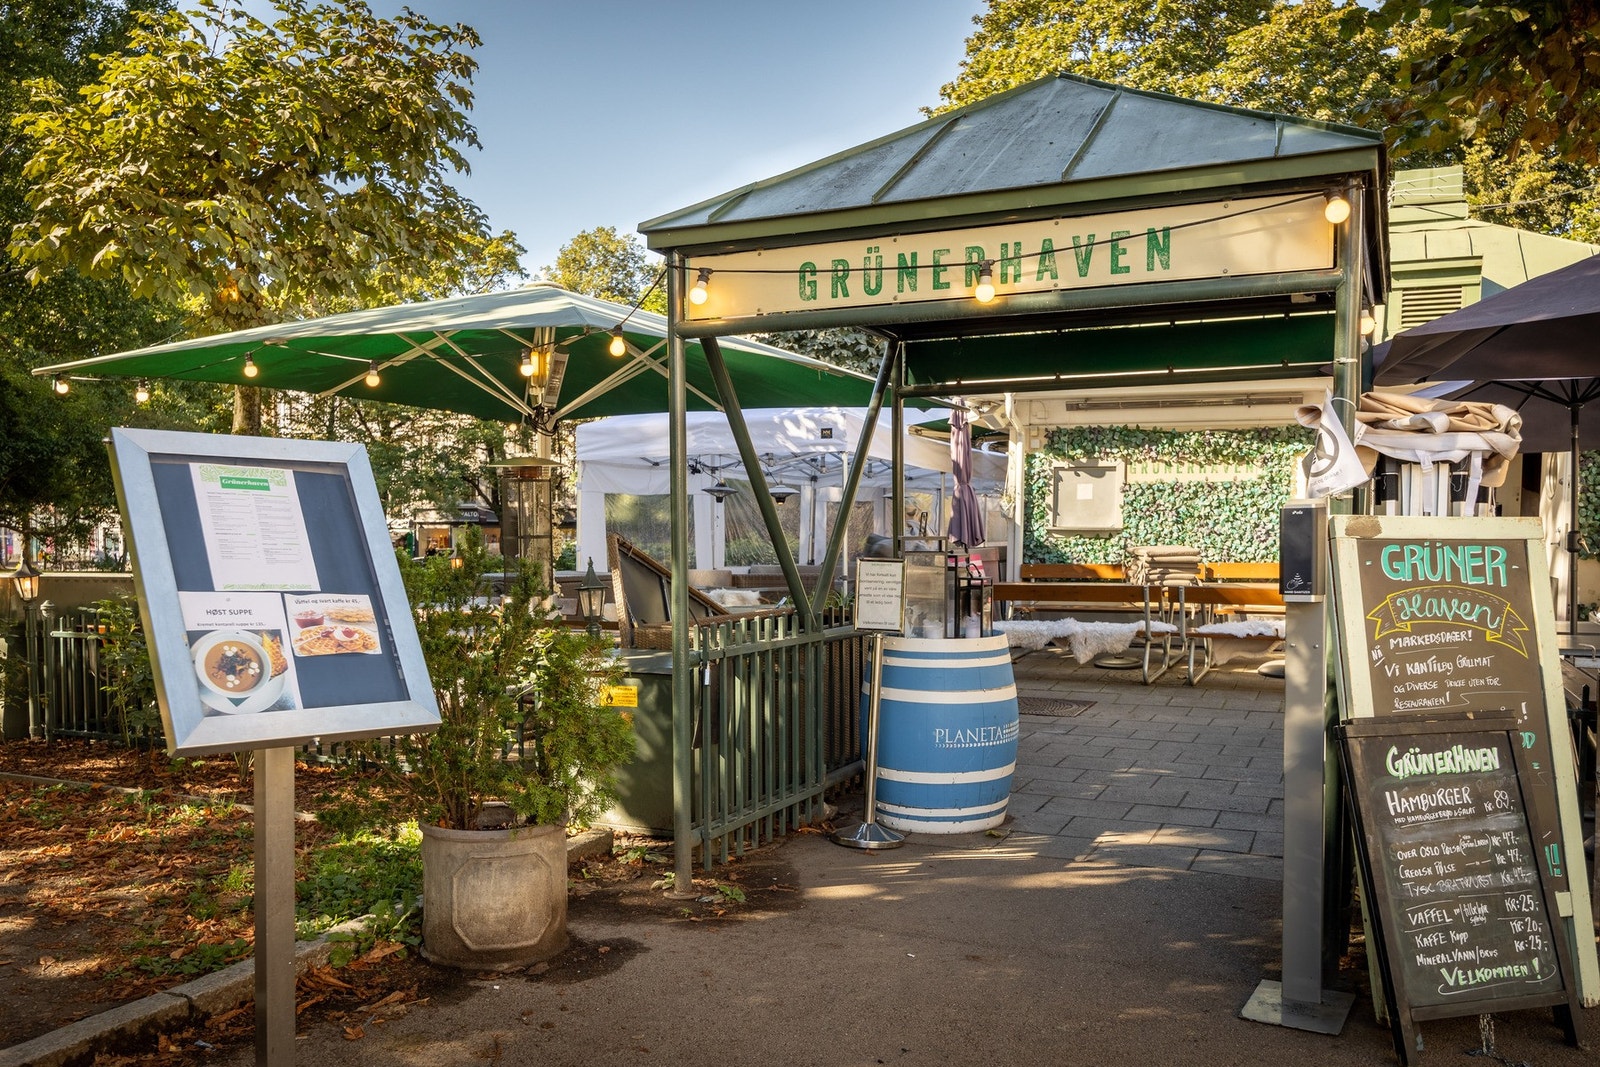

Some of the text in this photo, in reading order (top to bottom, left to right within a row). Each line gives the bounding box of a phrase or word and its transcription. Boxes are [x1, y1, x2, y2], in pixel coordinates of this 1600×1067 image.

[799, 226, 1171, 301] GRÜNERHAVEN
[1380, 541, 1508, 587] GRÜNER
[1396, 593, 1501, 629] Haven
[935, 726, 1004, 743] PLANETA
[1385, 744, 1501, 780] GRÜNERHAVEN
[1385, 786, 1472, 816] HAMBURGER
[1397, 848, 1418, 861] OVER
[1420, 845, 1440, 858] OSLO
[1433, 860, 1456, 877] PØLSE
[1436, 873, 1494, 893] BRATWURST
[1408, 907, 1453, 926] VAFFEL
[1414, 932, 1448, 949] KAFFE
